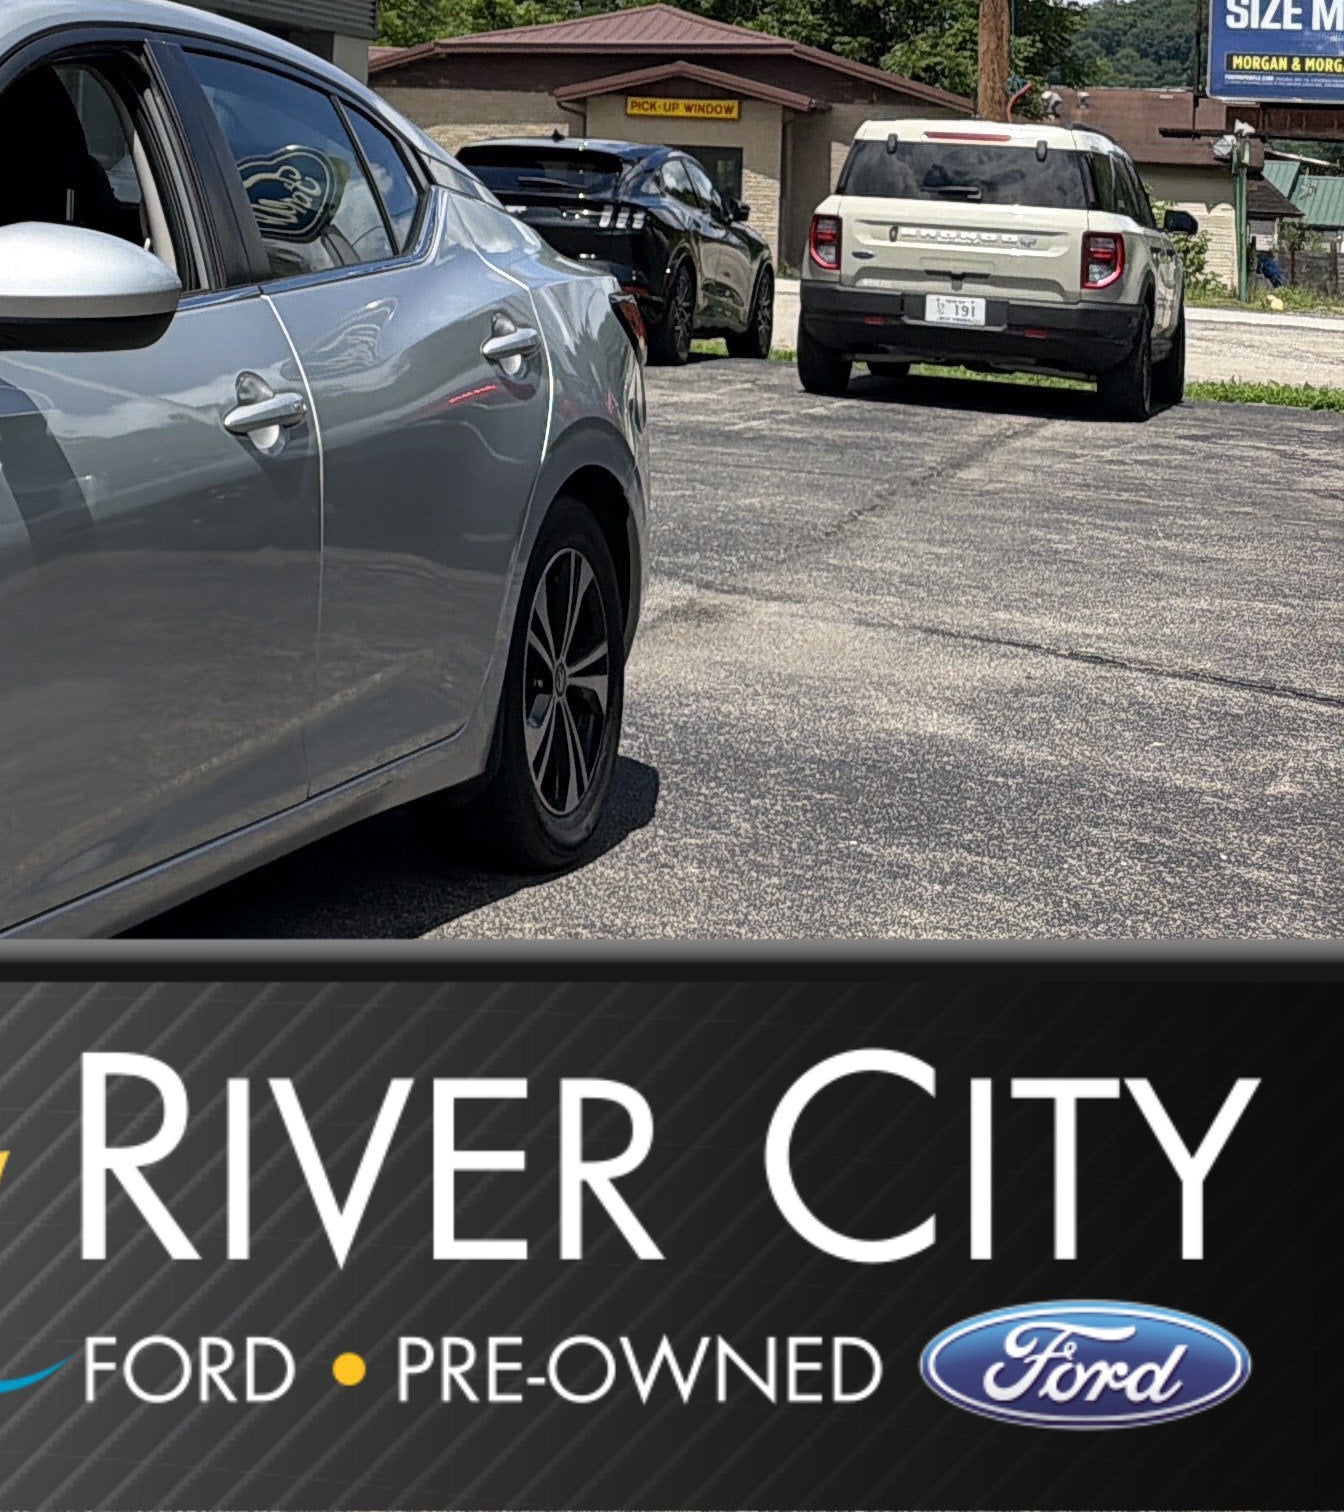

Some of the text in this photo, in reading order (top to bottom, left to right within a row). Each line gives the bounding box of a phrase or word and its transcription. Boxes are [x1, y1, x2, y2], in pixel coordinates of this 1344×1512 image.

[1232, 55, 1344, 72] MORGAN & MORG
[683, 102, 734, 115] WINDOW
